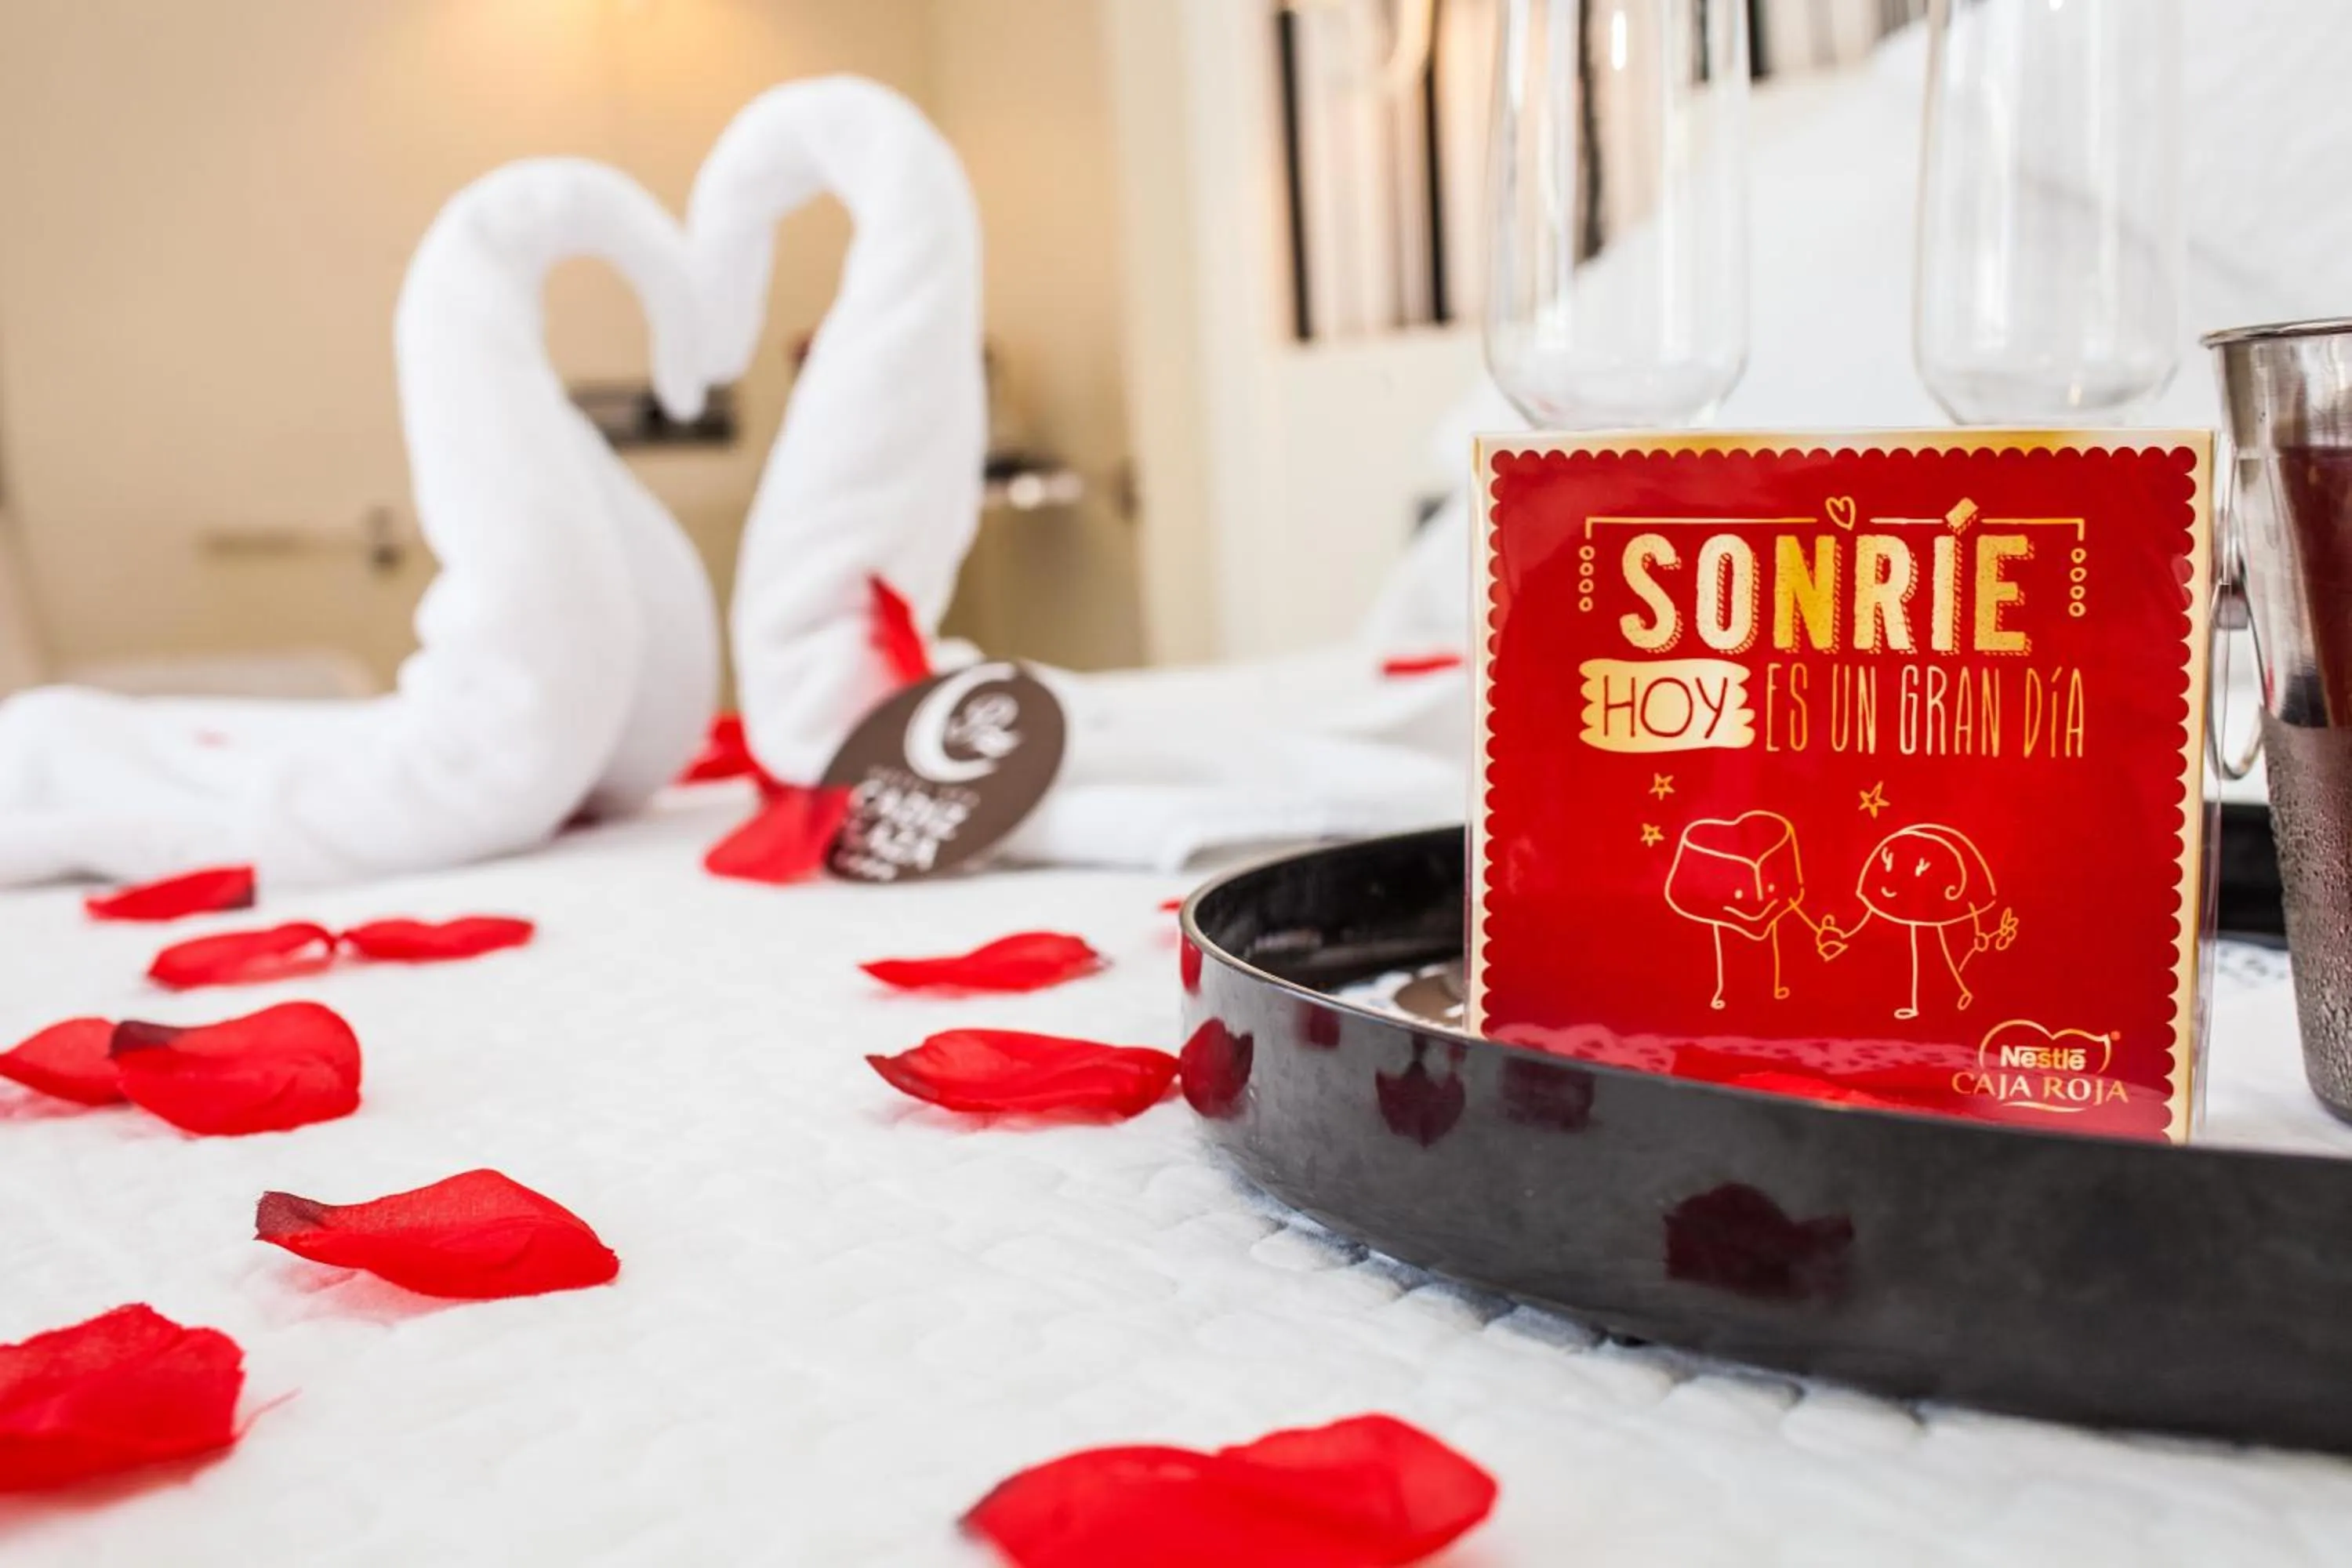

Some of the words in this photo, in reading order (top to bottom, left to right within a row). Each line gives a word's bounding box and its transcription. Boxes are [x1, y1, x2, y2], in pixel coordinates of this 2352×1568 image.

[1619, 497, 2035, 655] SONRÍE
[1603, 674, 1729, 739] HOY
[1766, 662, 1809, 752] ES
[1831, 663, 1877, 755] UN
[1899, 664, 2001, 757] GRAN
[1951, 1071, 2034, 1101] CAJA
[2042, 1075, 2130, 1106] ROJA
[2000, 1045, 2087, 1071] Nestlé
